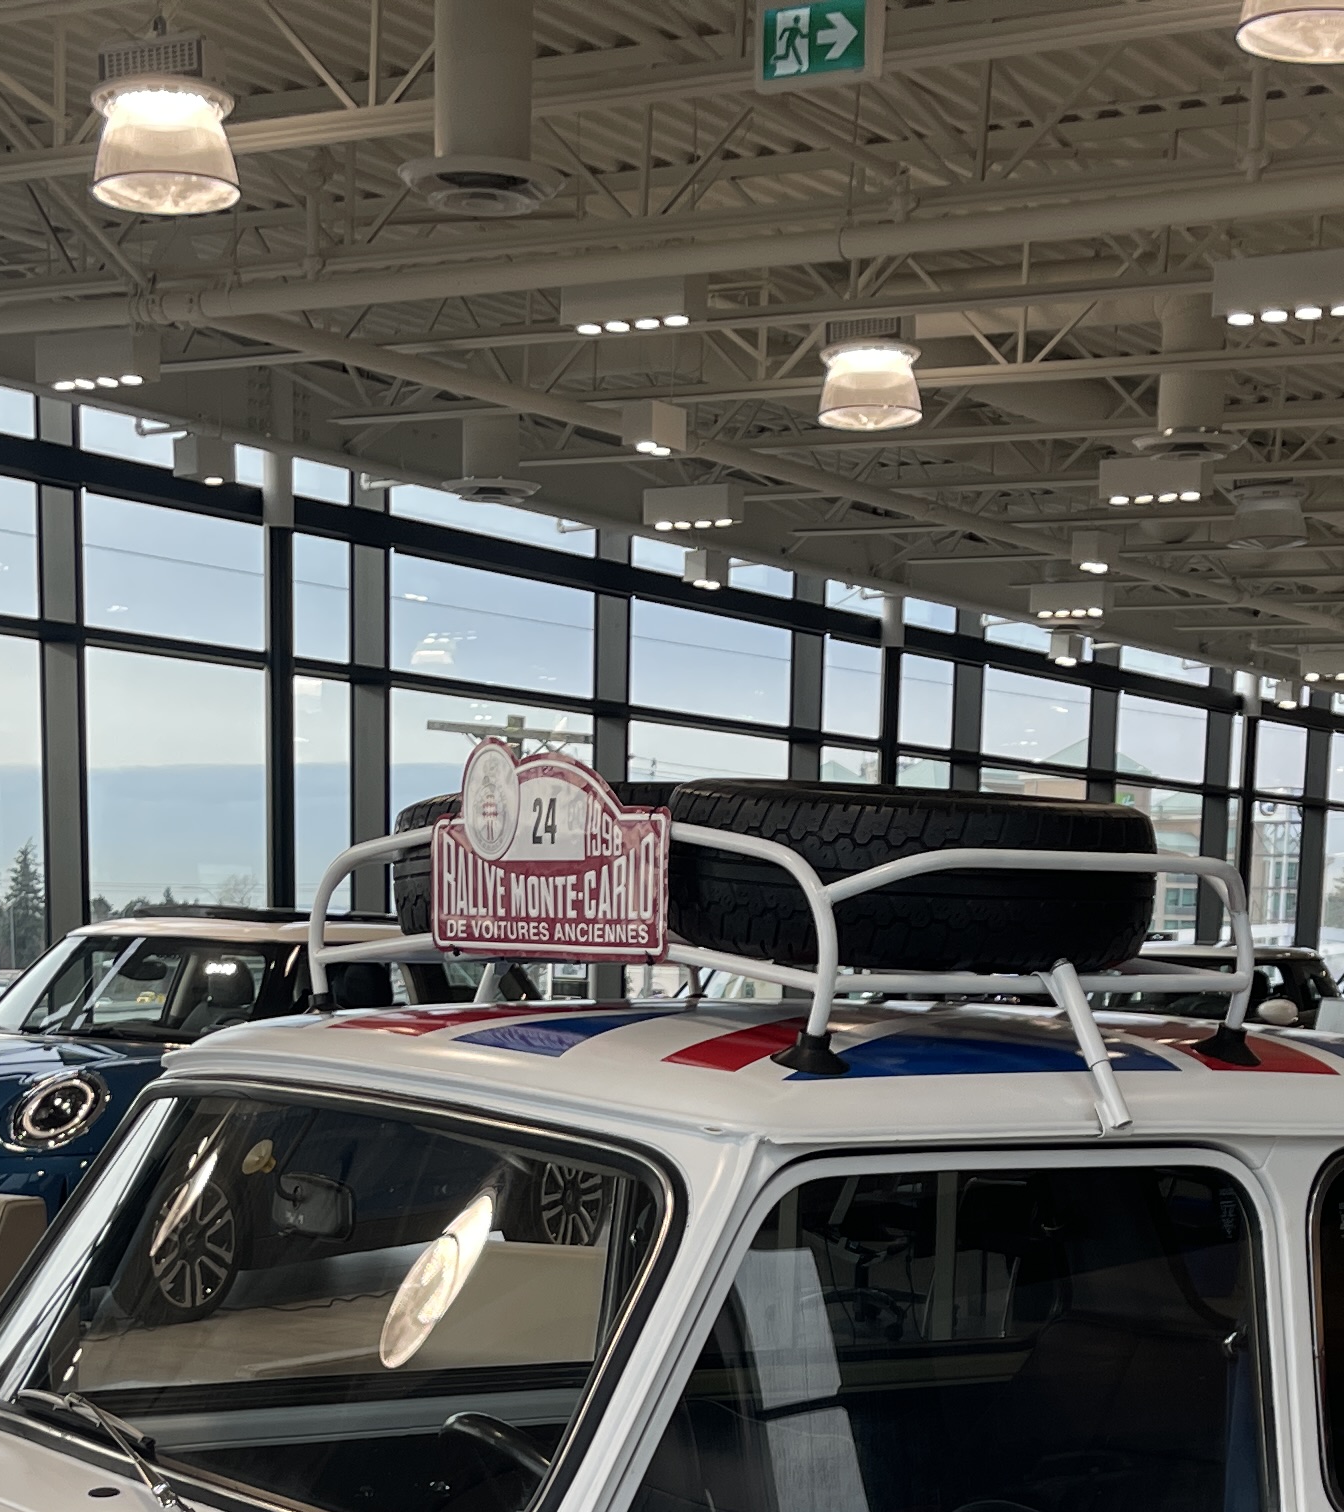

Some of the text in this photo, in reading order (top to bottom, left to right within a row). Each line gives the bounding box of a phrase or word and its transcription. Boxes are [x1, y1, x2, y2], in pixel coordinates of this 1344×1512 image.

[531, 797, 557, 845] 24
[586, 794, 623, 857] 1998
[442, 831, 655, 921] RALLYE MONTE-CARLO
[446, 919, 649, 945] DE VOITURES ANCIENNES
